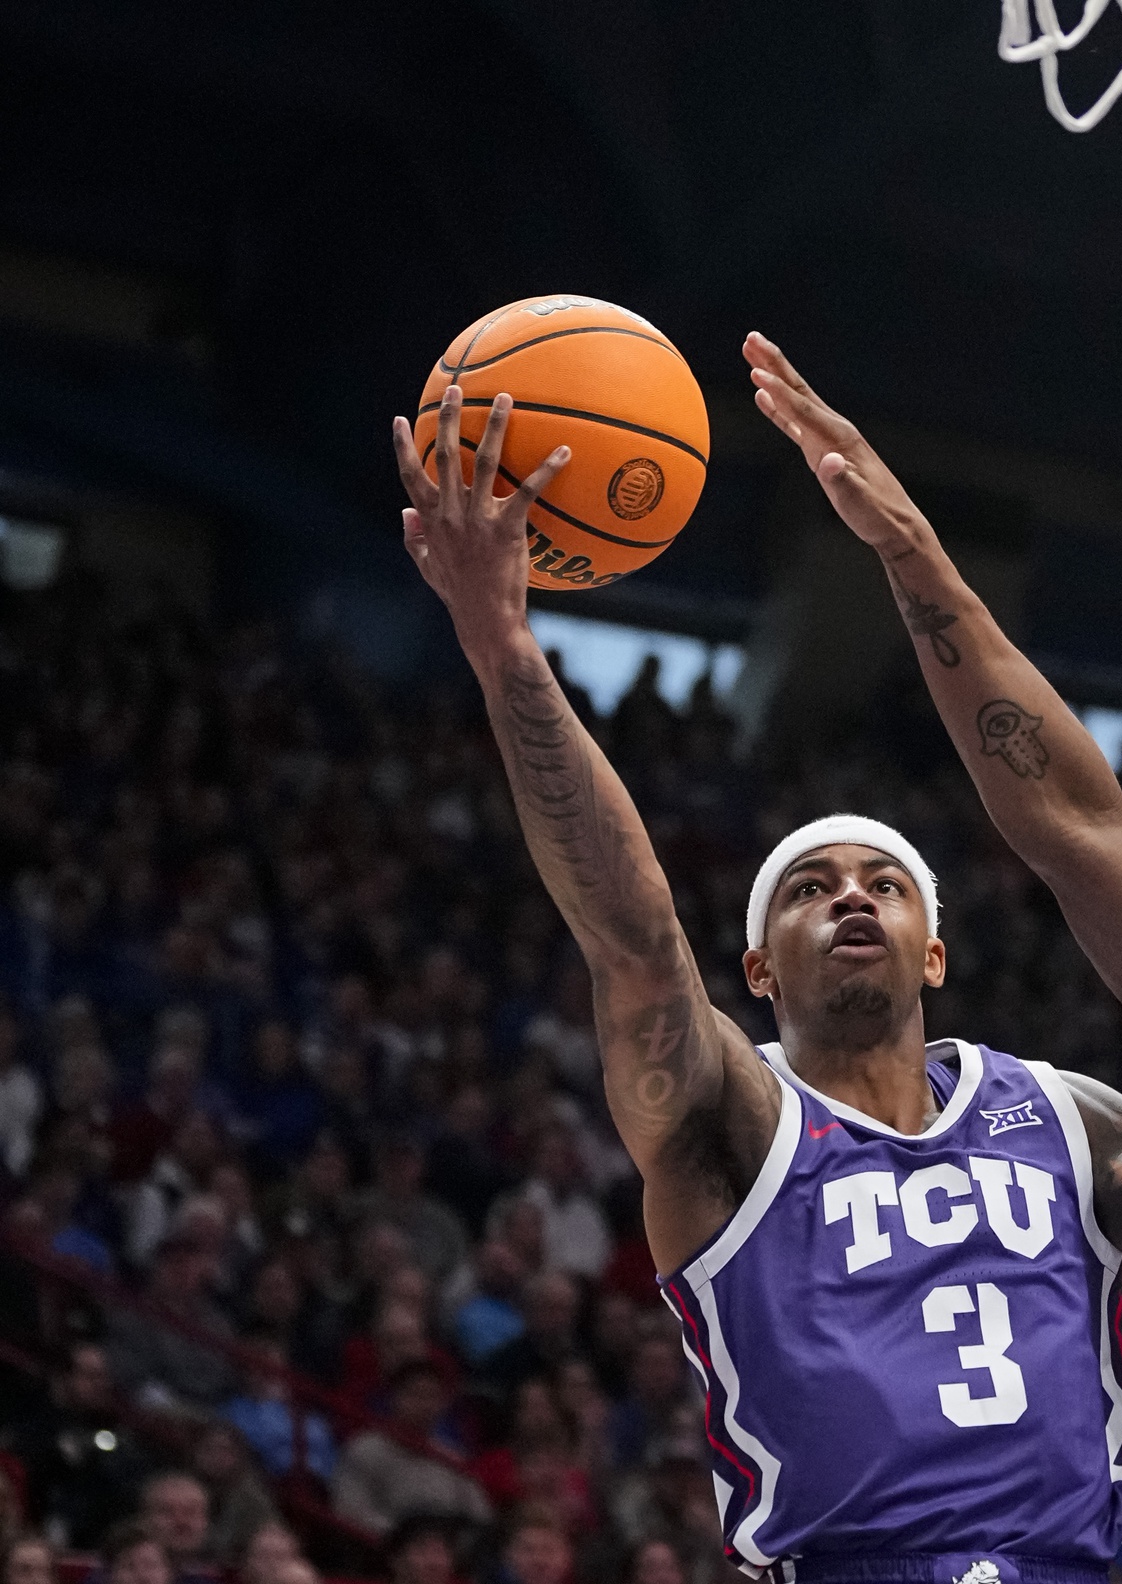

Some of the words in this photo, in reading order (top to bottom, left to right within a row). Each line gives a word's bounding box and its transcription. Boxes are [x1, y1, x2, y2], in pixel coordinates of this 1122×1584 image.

[527, 521, 623, 584] ilso
[822, 1156, 1057, 1275] TCU
[921, 1283, 1028, 1427] 3
